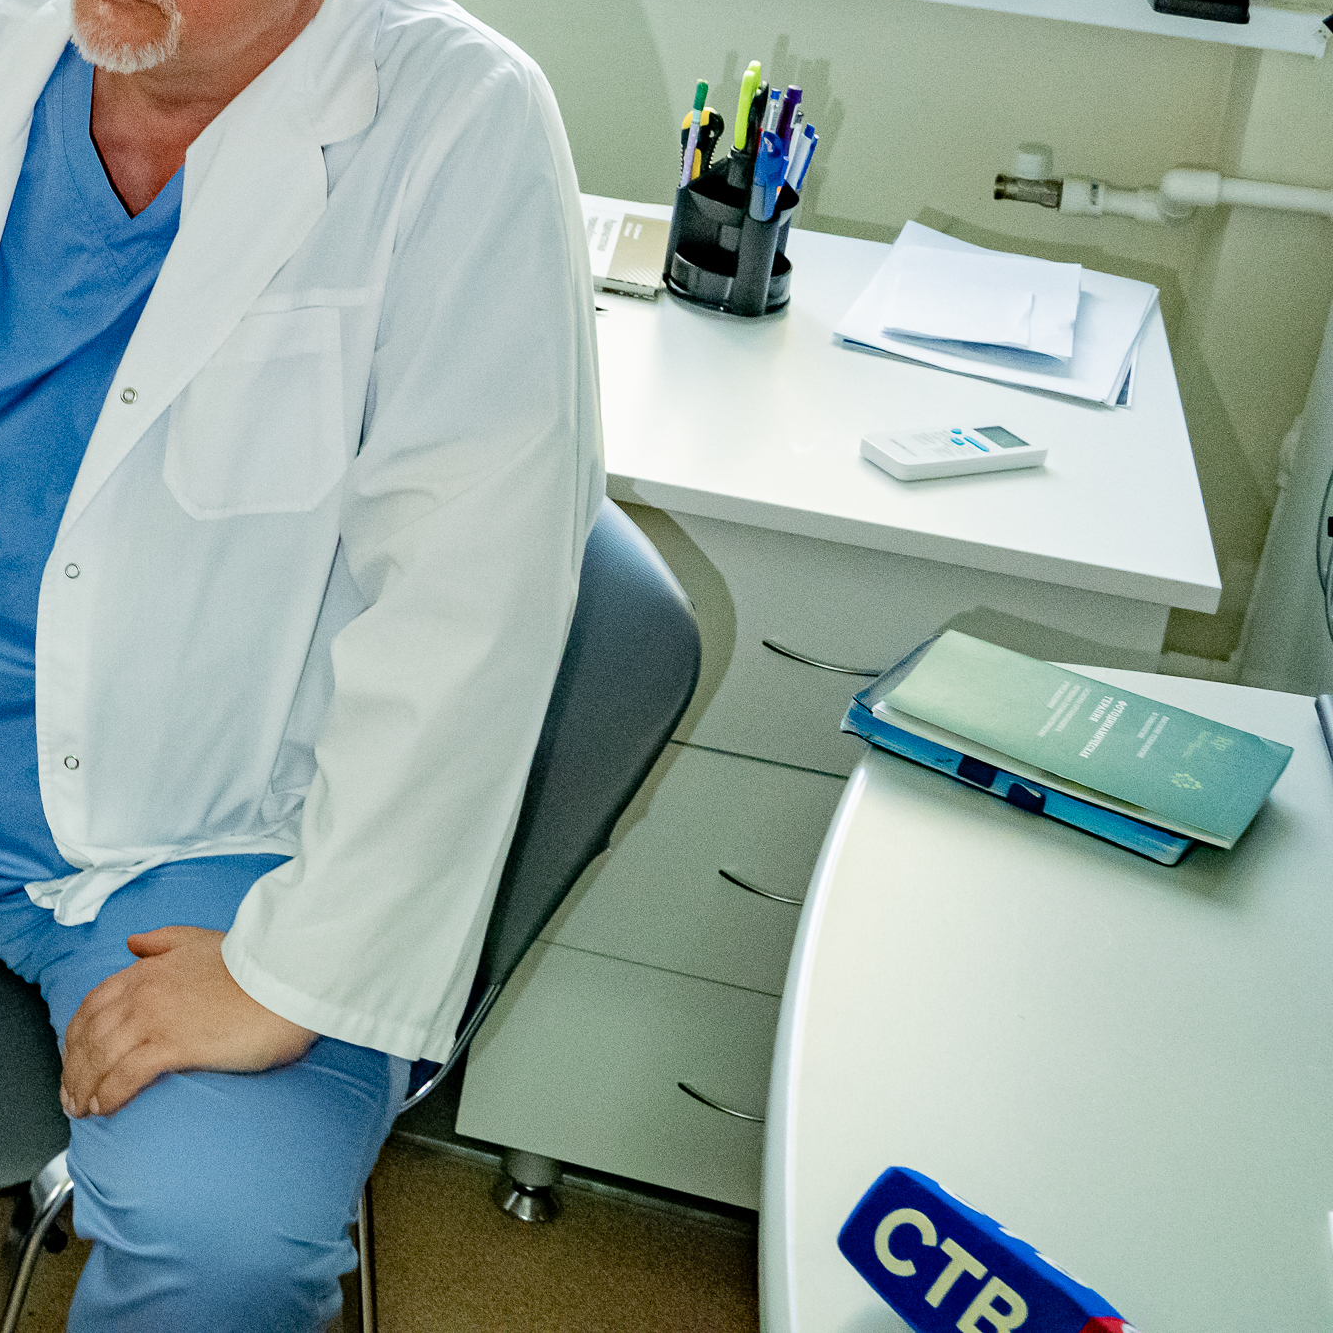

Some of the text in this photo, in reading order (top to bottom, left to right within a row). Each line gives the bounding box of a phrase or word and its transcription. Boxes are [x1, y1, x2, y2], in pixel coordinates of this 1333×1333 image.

[1079, 699, 1128, 759] ФОТОДИНАМИЧЕСКАЯ
[1089, 695, 1114, 723] ТЕРАПИЯ
[874, 1208, 1029, 1333] СТВ
